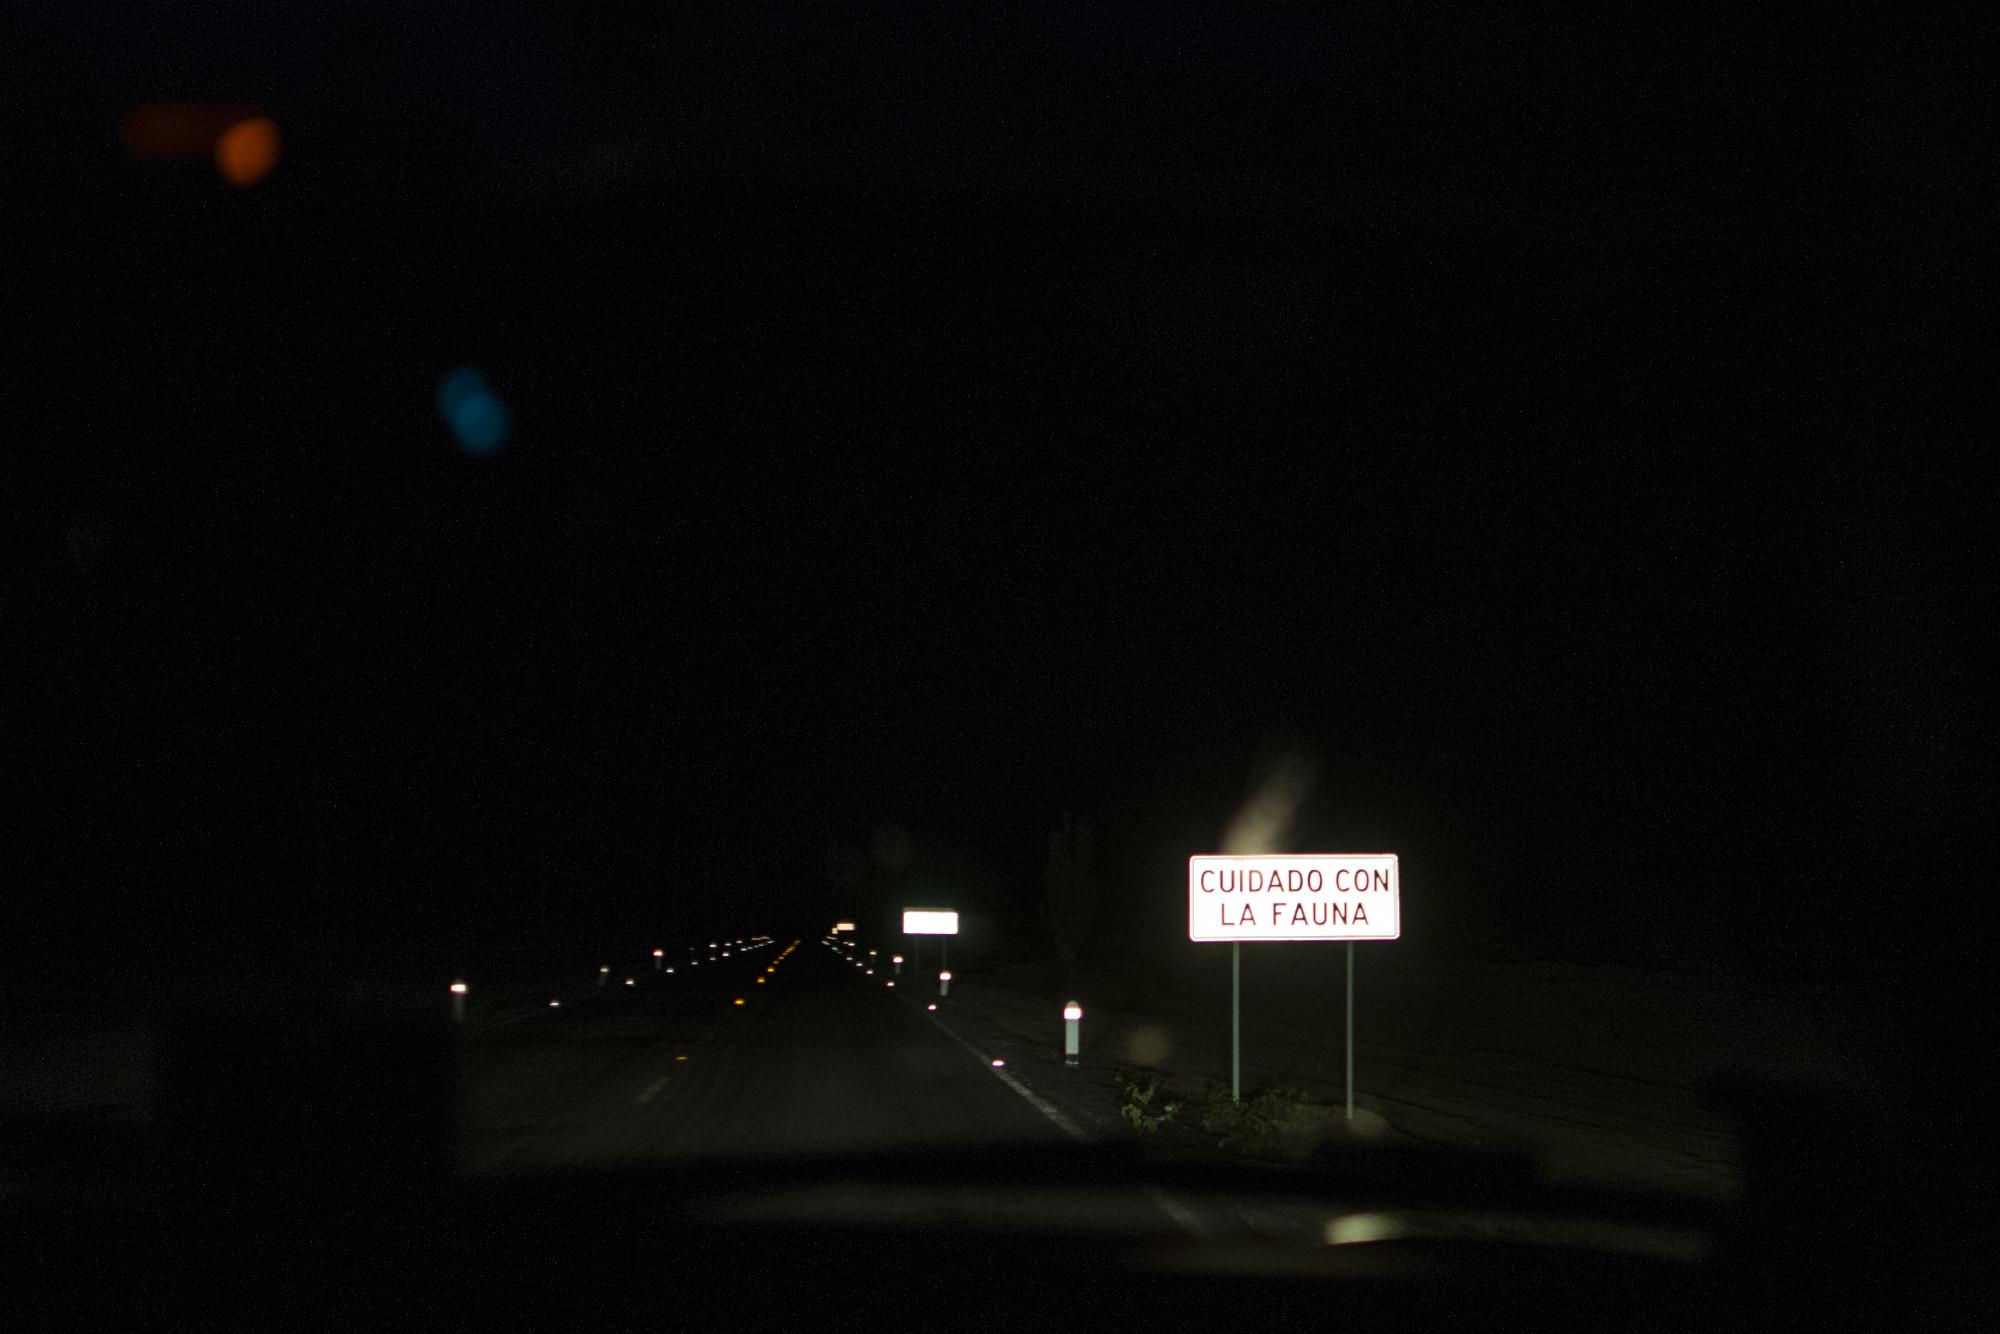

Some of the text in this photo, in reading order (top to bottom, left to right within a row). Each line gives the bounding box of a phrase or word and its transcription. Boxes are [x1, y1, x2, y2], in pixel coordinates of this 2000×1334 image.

[1200, 868, 1389, 893] CUIDADO CON
[1221, 902, 1369, 926] LA FAUNA
